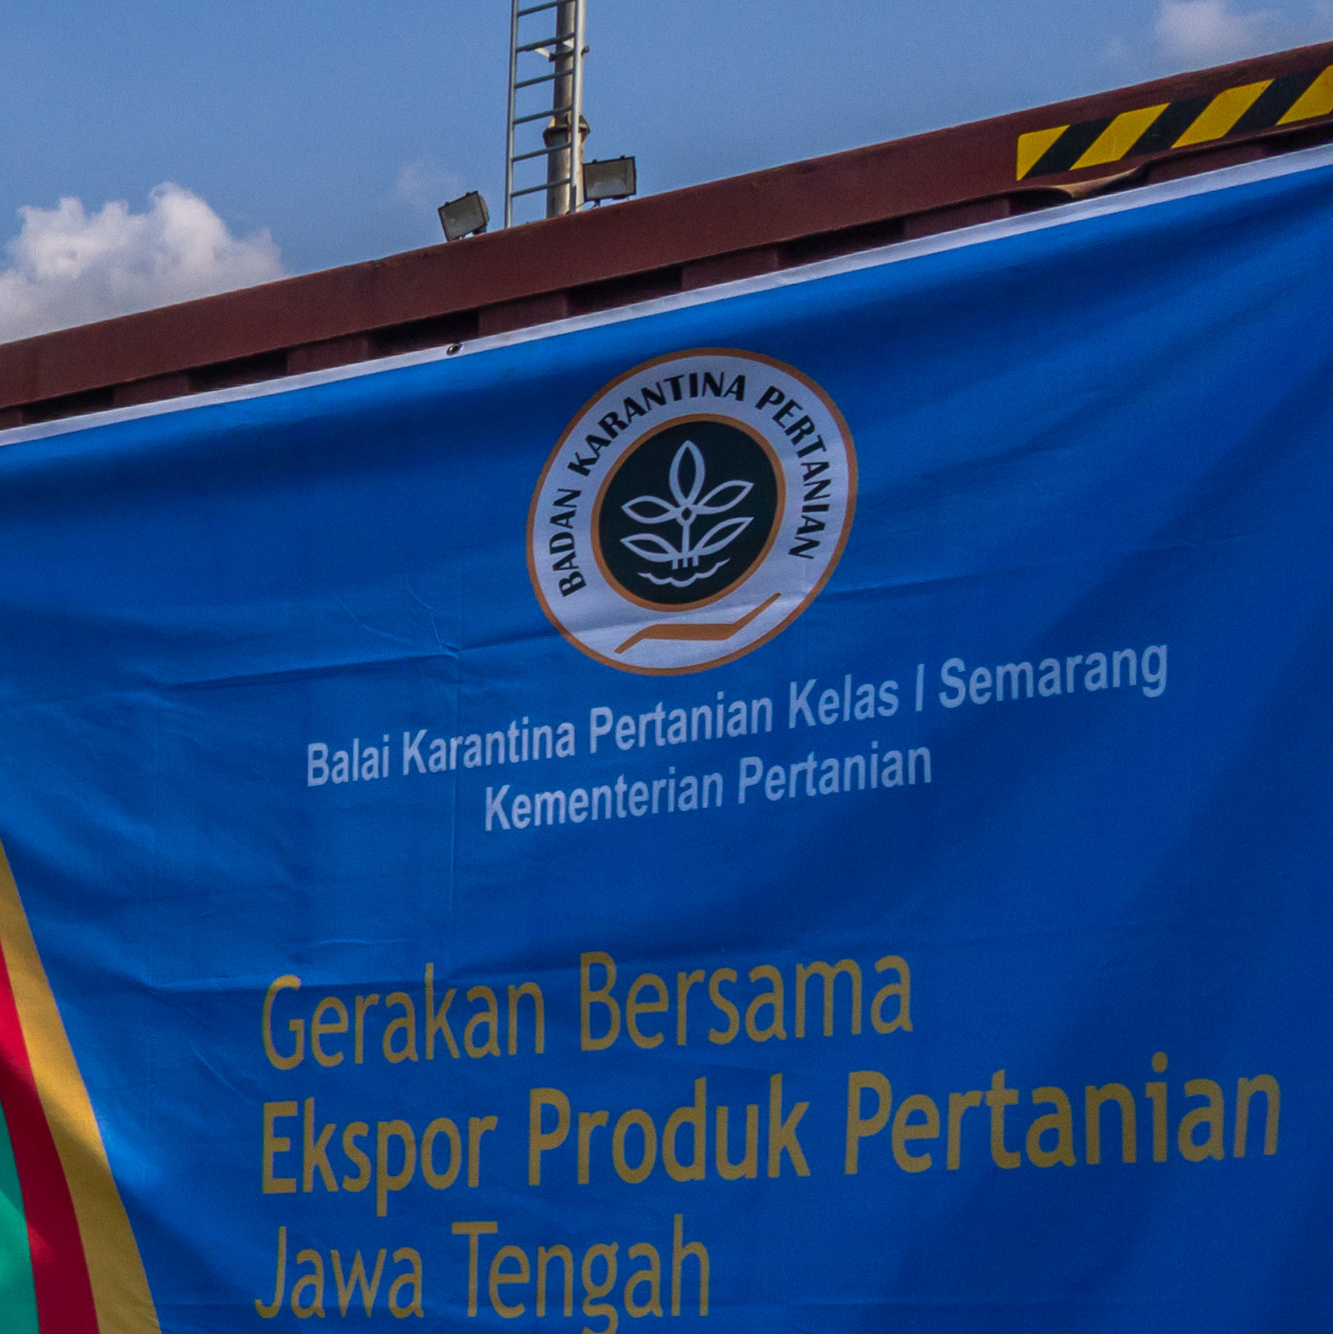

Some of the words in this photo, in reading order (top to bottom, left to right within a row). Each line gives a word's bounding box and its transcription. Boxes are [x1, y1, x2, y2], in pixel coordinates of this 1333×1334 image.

[567, 371, 747, 478] KARANTINA
[754, 384, 833, 561] PERTANIAN
[558, 487, 588, 597] BADAN
[306, 729, 390, 788] Balai
[402, 713, 576, 776] Karantina
[588, 690, 775, 757] Pertanian
[787, 676, 900, 728] Kelas
[939, 637, 1170, 711] Semarang
[483, 771, 724, 833] Kementerian
[737, 740, 933, 807] Pertanian
[262, 963, 545, 1071] Gerakan
[580, 950, 914, 1051] Bersama
[262, 1096, 497, 1217] Ekspor
[531, 1074, 811, 1186] Produk
[846, 1052, 1282, 1175] Pertanian
[254, 1226, 424, 1320] Jawa
